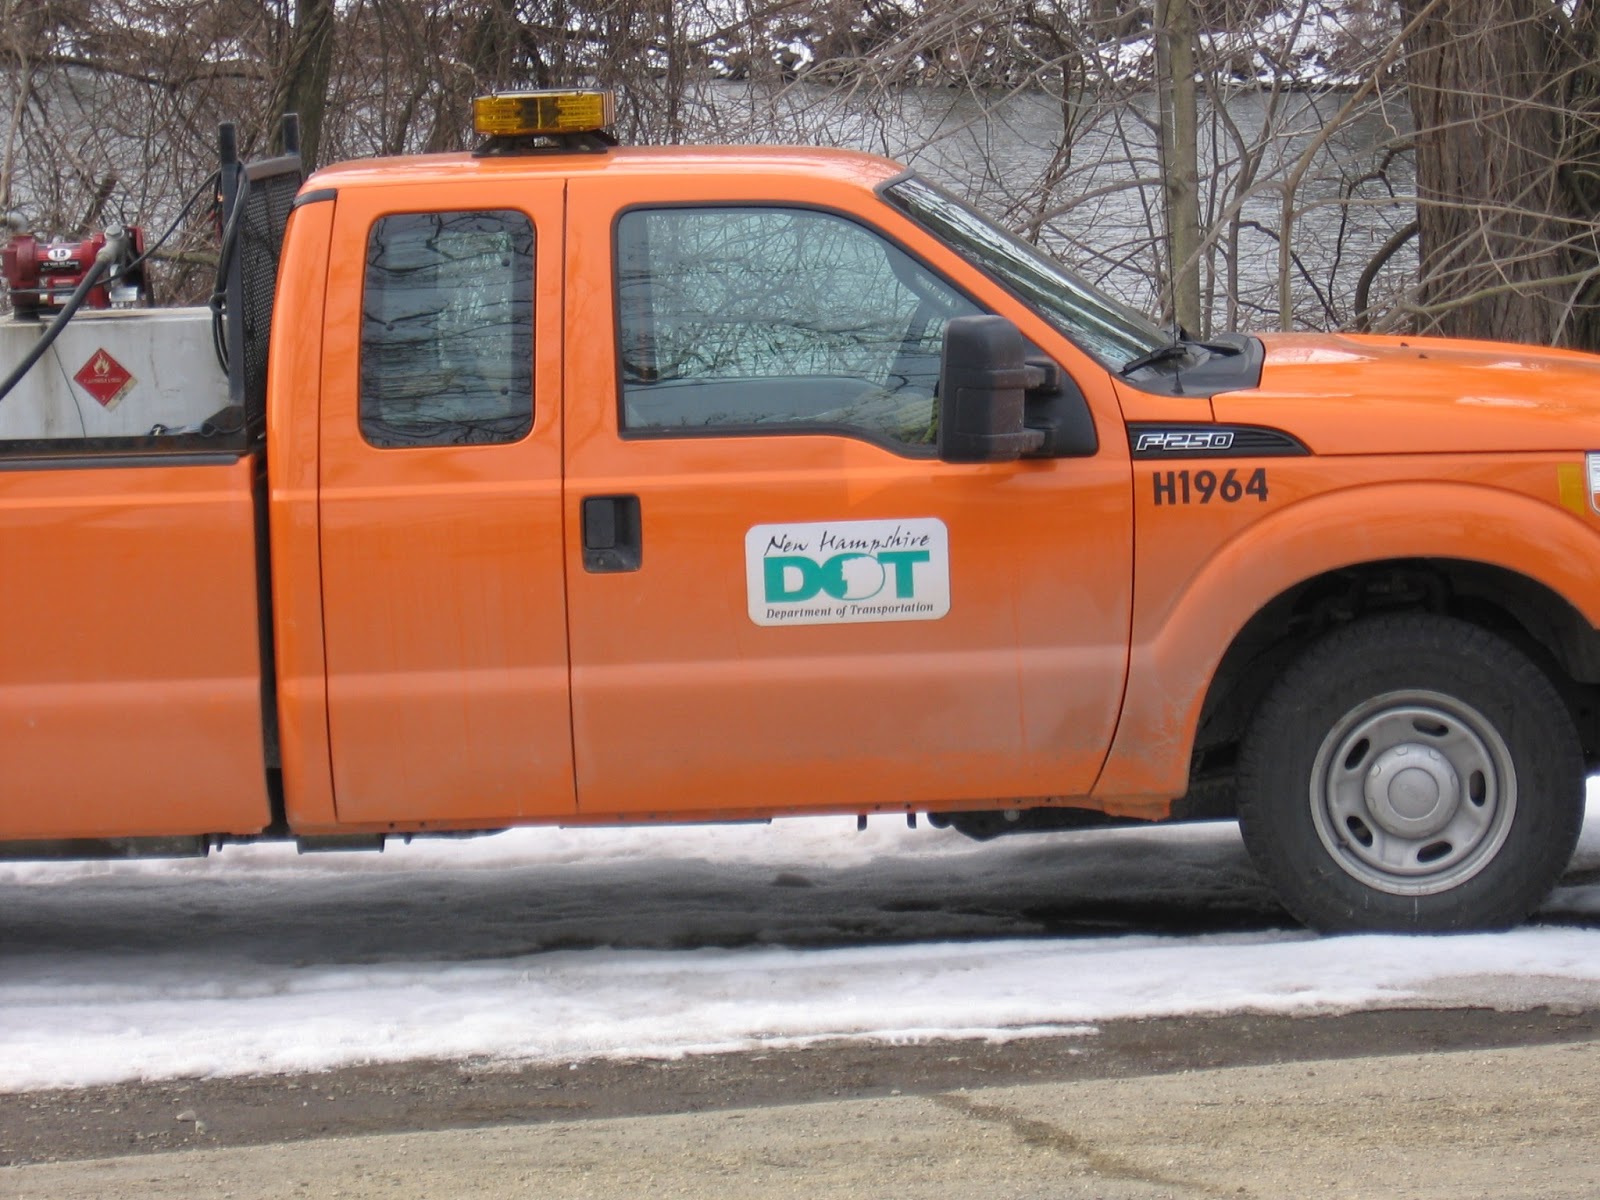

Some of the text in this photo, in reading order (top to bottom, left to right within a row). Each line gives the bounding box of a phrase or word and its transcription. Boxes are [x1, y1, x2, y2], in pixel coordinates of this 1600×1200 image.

[54, 250, 66, 258] 15
[1136, 432, 1234, 451] F-250
[1153, 468, 1268, 505] H1964
[765, 525, 930, 555] New Hampshire
[764, 550, 930, 603] DOT
[766, 602, 934, 619] Department of Transportation
